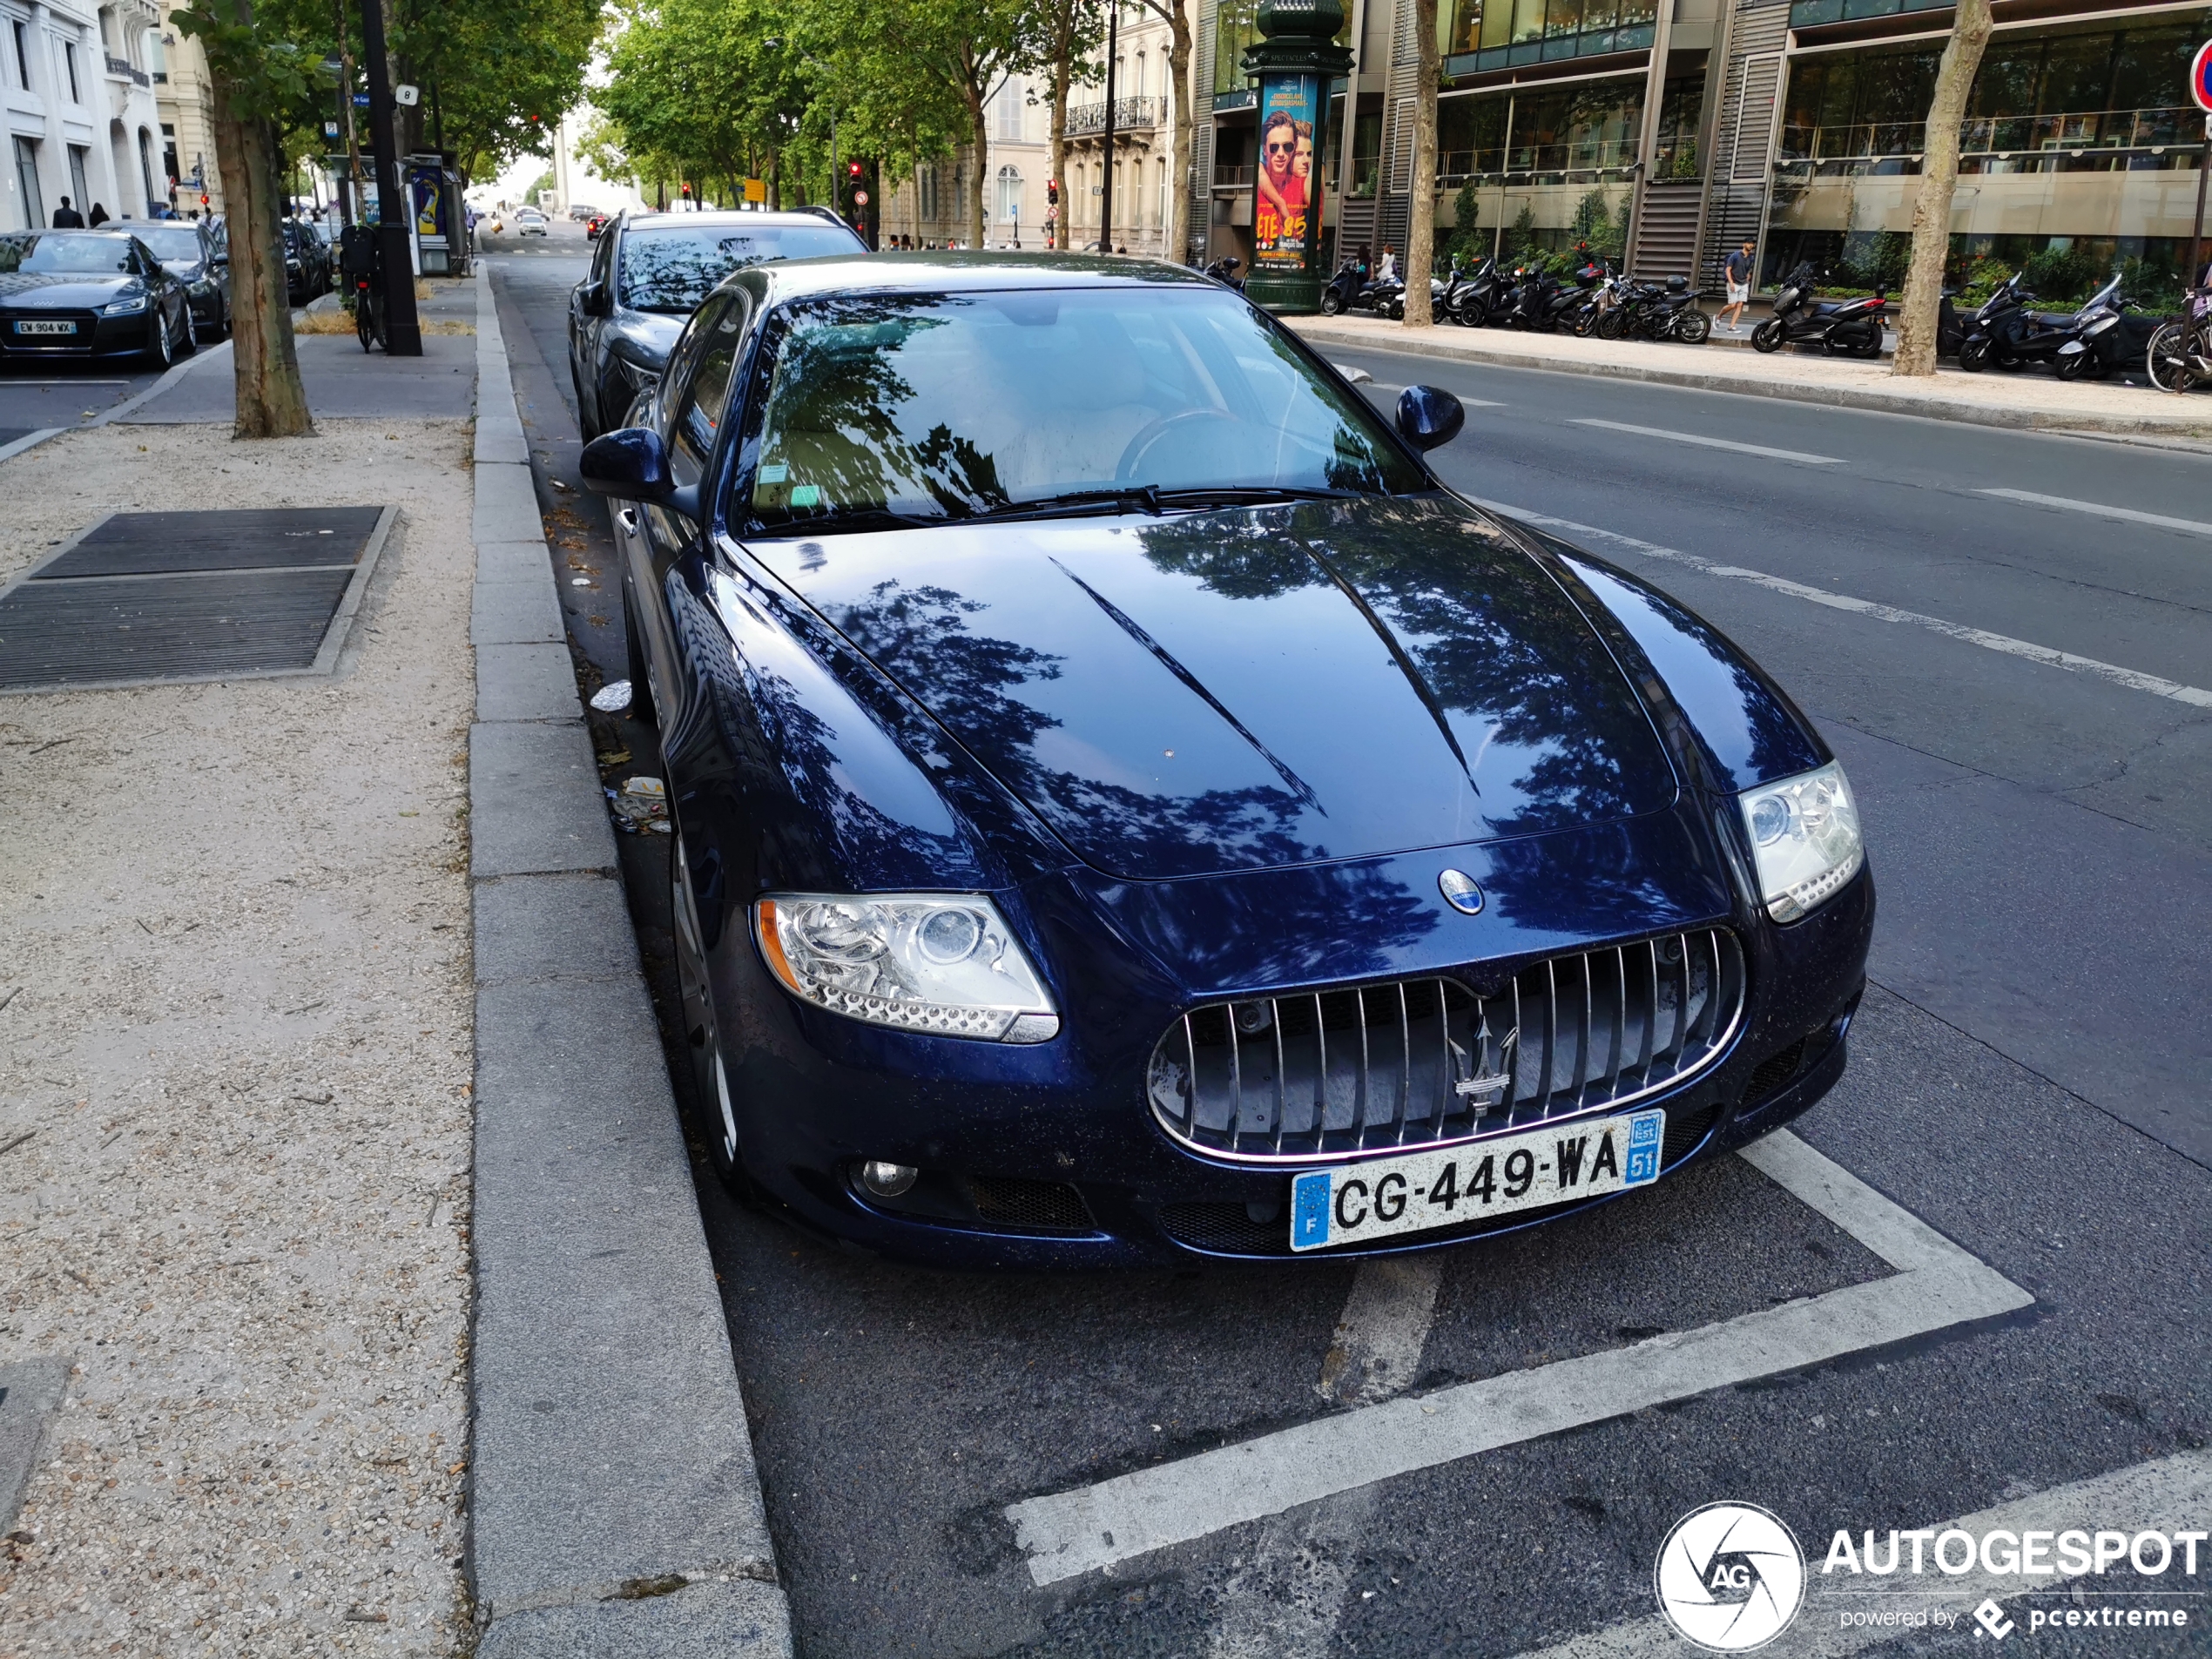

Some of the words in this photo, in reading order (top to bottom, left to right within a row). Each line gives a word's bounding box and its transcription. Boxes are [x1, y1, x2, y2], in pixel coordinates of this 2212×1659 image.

[405, 91, 411, 99] 8
[1257, 212, 1278, 239] ÉTÉ
[1283, 215, 1307, 237] 85
[20, 323, 70, 332] EW-904-WX
[1630, 1151, 1655, 1177] 51
[1335, 1130, 1618, 1229] CG-449-WA
[1306, 1217, 1317, 1233] F
